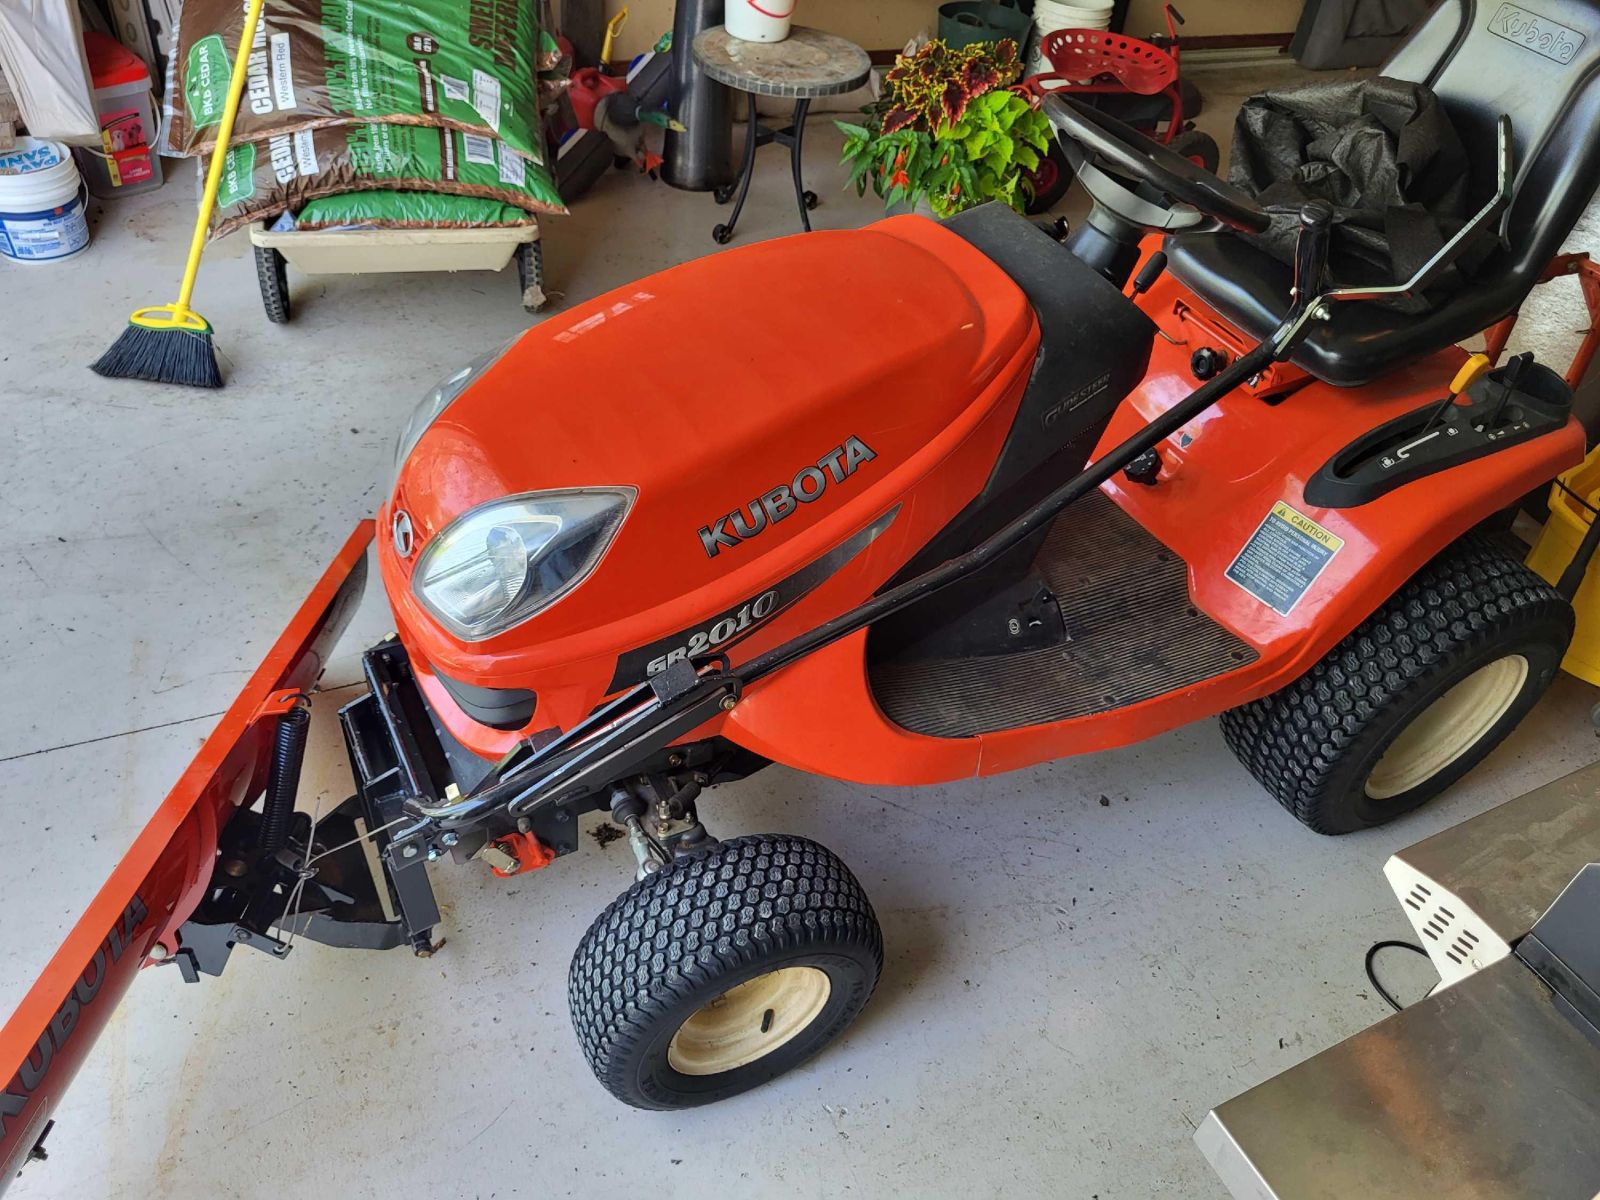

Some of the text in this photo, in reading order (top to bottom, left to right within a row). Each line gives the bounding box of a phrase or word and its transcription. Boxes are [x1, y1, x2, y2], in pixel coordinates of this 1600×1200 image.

[1496, 6, 1574, 60] Kubota
[199, 43, 212, 88] CEDAR
[247, 50, 273, 115] CEDAR
[276, 41, 290, 103] Western Red
[226, 170, 239, 195] BKB
[697, 434, 878, 559] KUBOTA
[1288, 526, 1311, 547] PERSONAL
[1310, 541, 1329, 557] INJURY
[1290, 515, 1332, 544] CAUTION
[646, 590, 781, 677] GR2010
